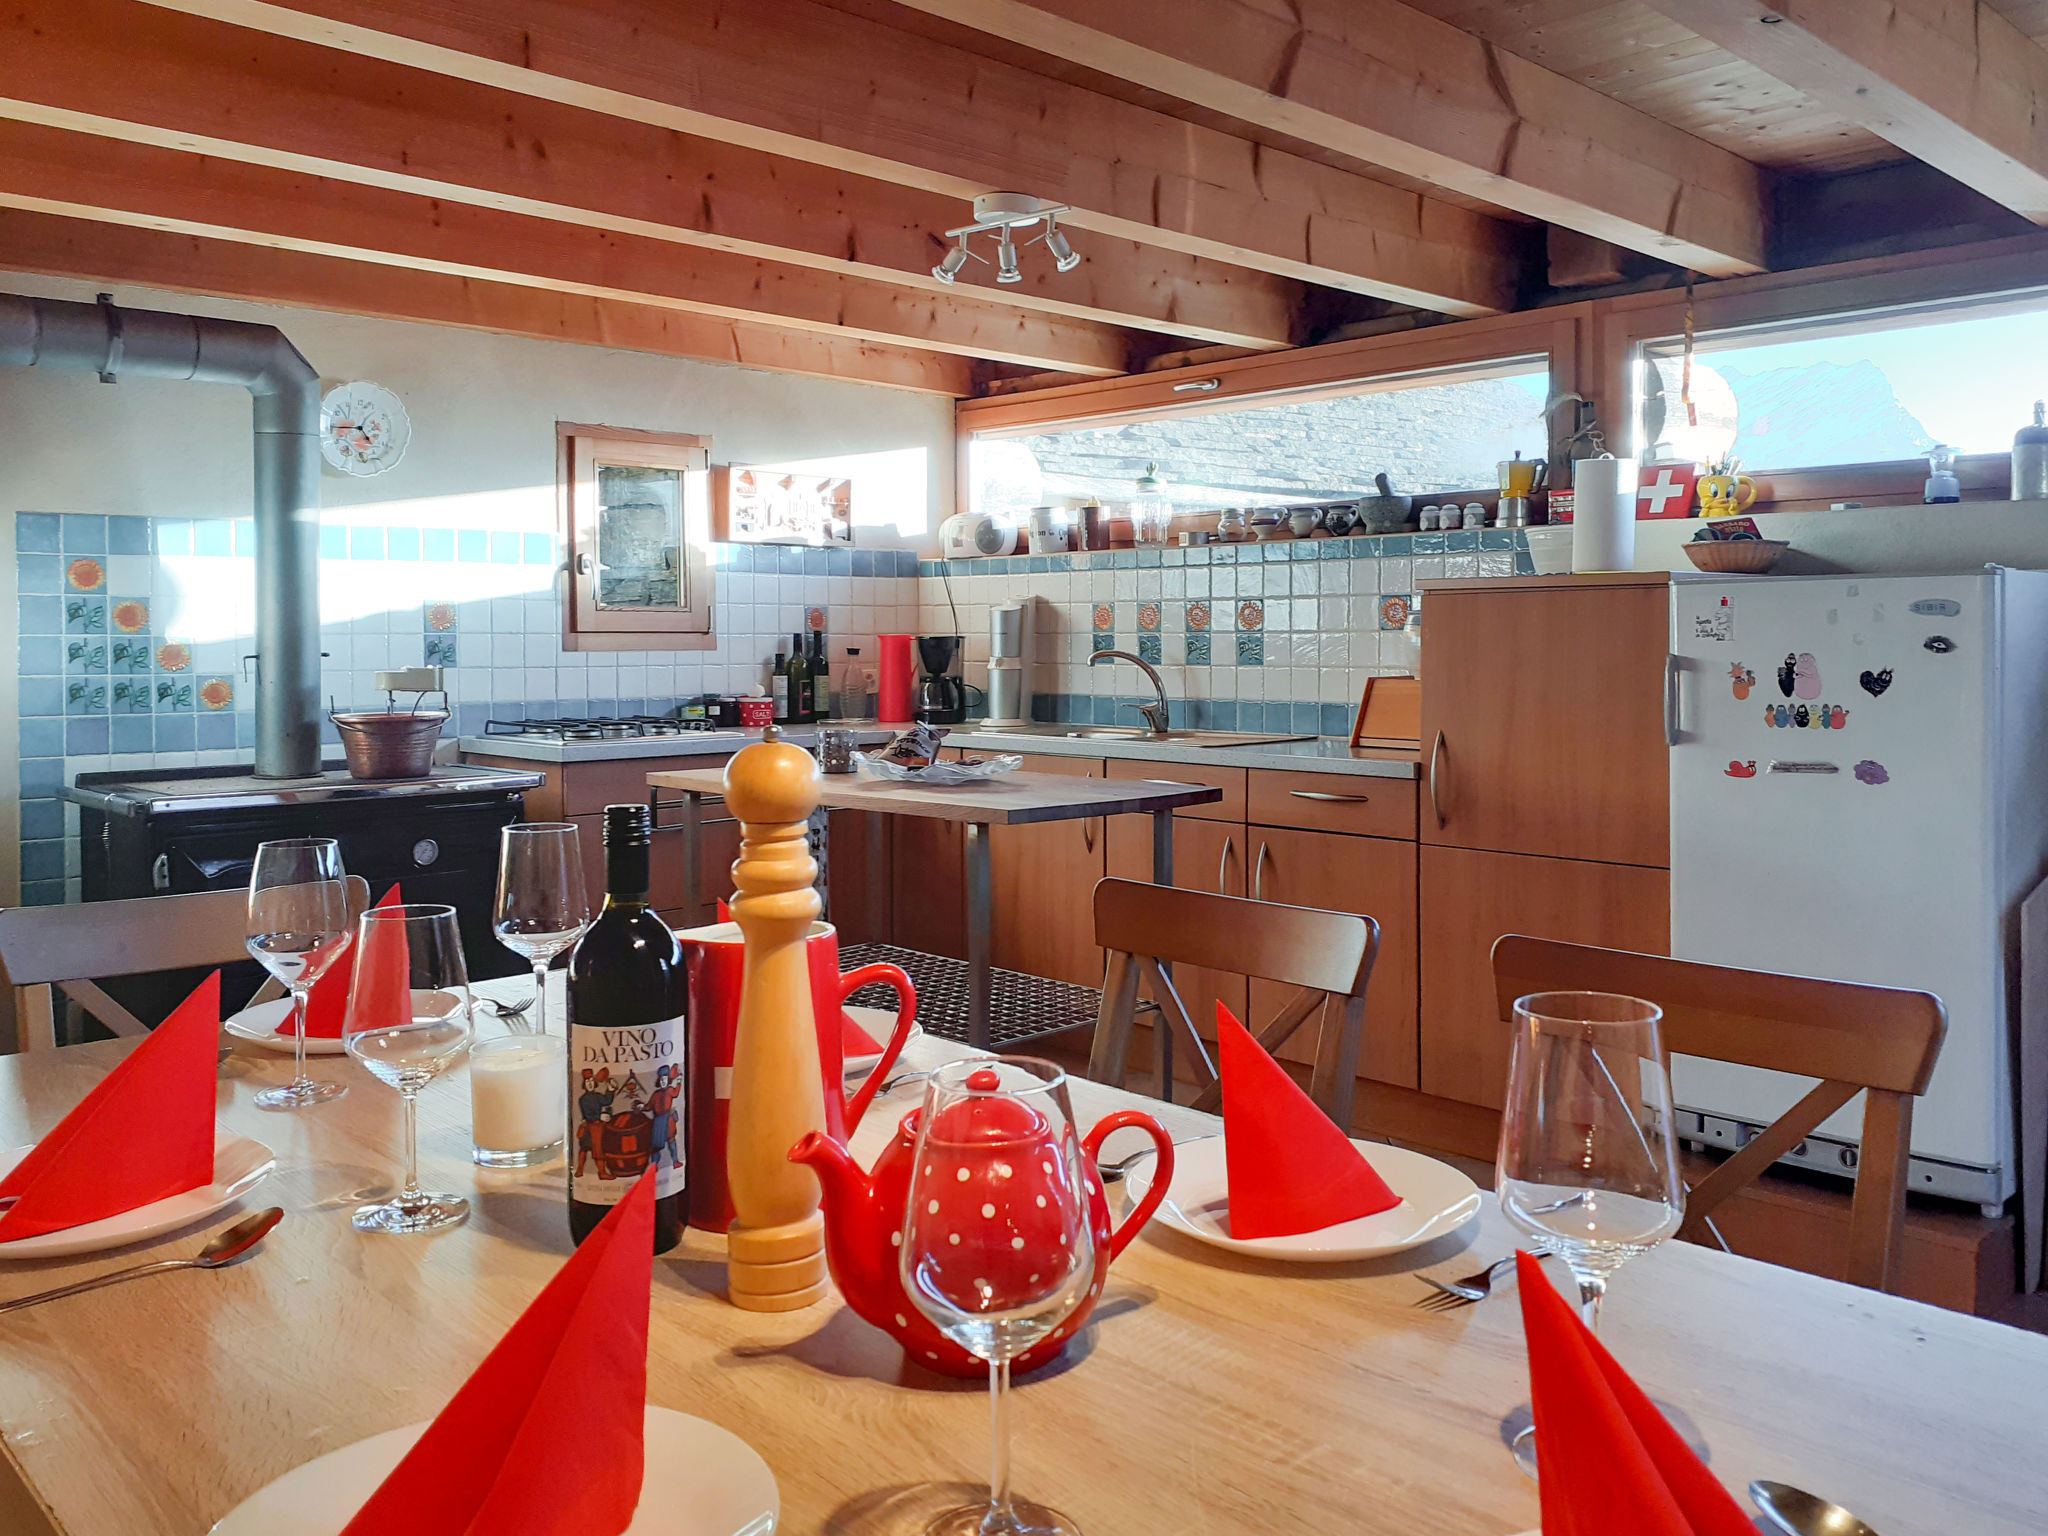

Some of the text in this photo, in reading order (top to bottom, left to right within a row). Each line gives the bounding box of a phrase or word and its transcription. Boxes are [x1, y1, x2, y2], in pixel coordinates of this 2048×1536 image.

[754, 710, 771, 718] SALT
[602, 1028, 657, 1047] VINO
[583, 1040, 674, 1063] DA PASTO
